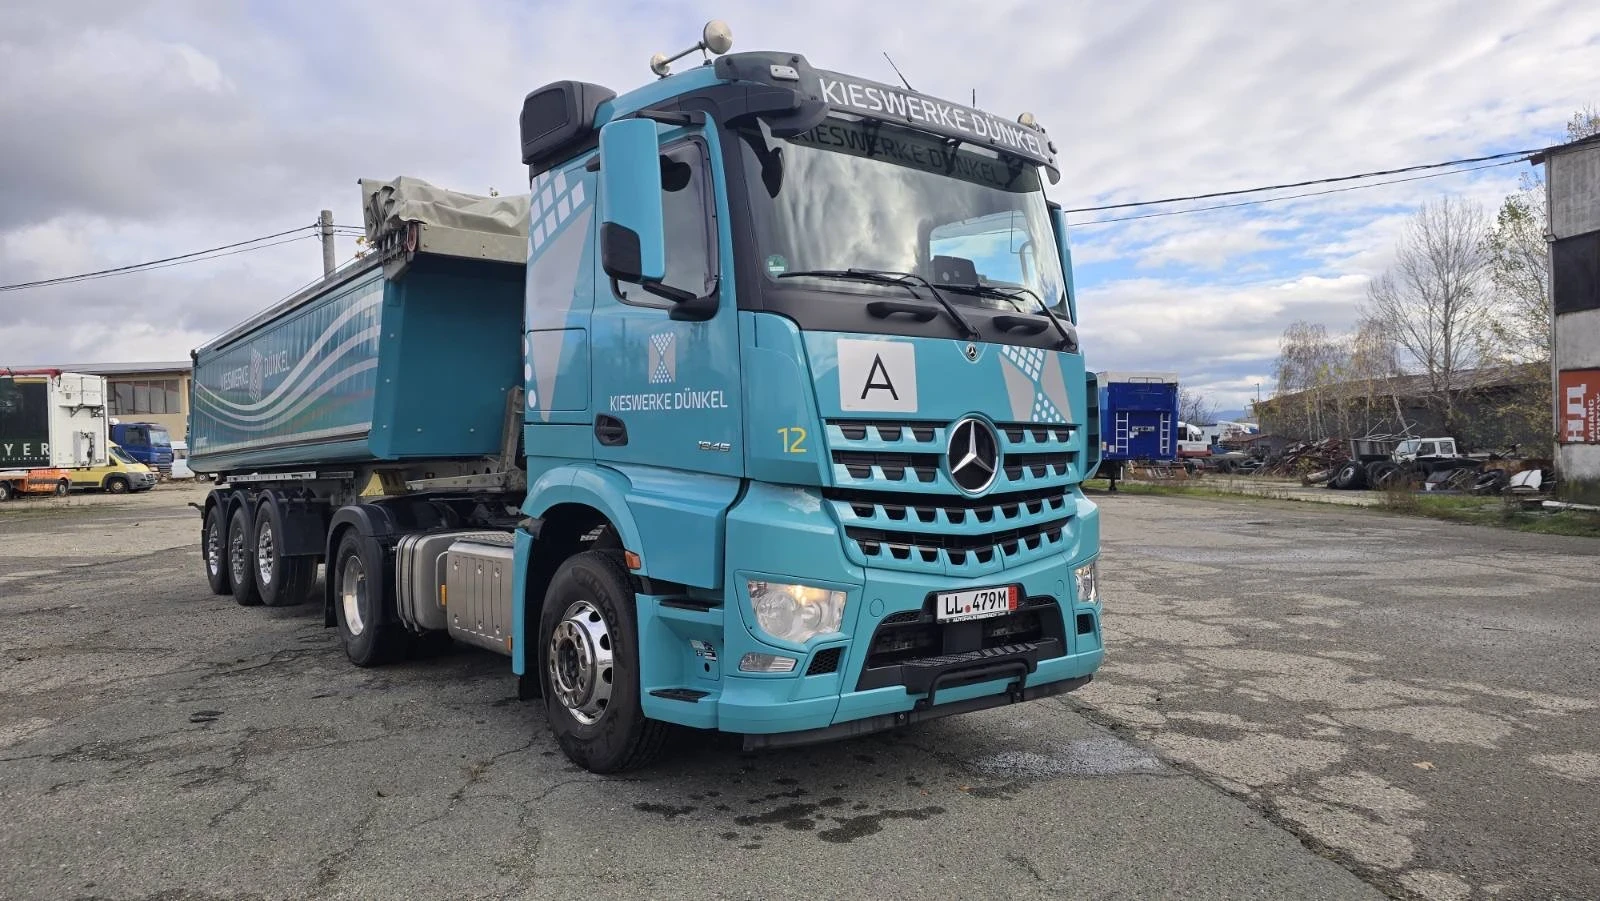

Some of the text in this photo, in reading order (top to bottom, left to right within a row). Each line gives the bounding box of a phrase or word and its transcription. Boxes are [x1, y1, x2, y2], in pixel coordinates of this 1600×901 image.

[819, 78, 1047, 159] KIESWERKE DÜNKEL
[860, 353, 899, 401] A
[610, 387, 728, 412] KIESWERKE DÜNKEL
[777, 427, 808, 453] 12
[946, 596, 963, 615] LL
[972, 590, 1007, 611] 479M
